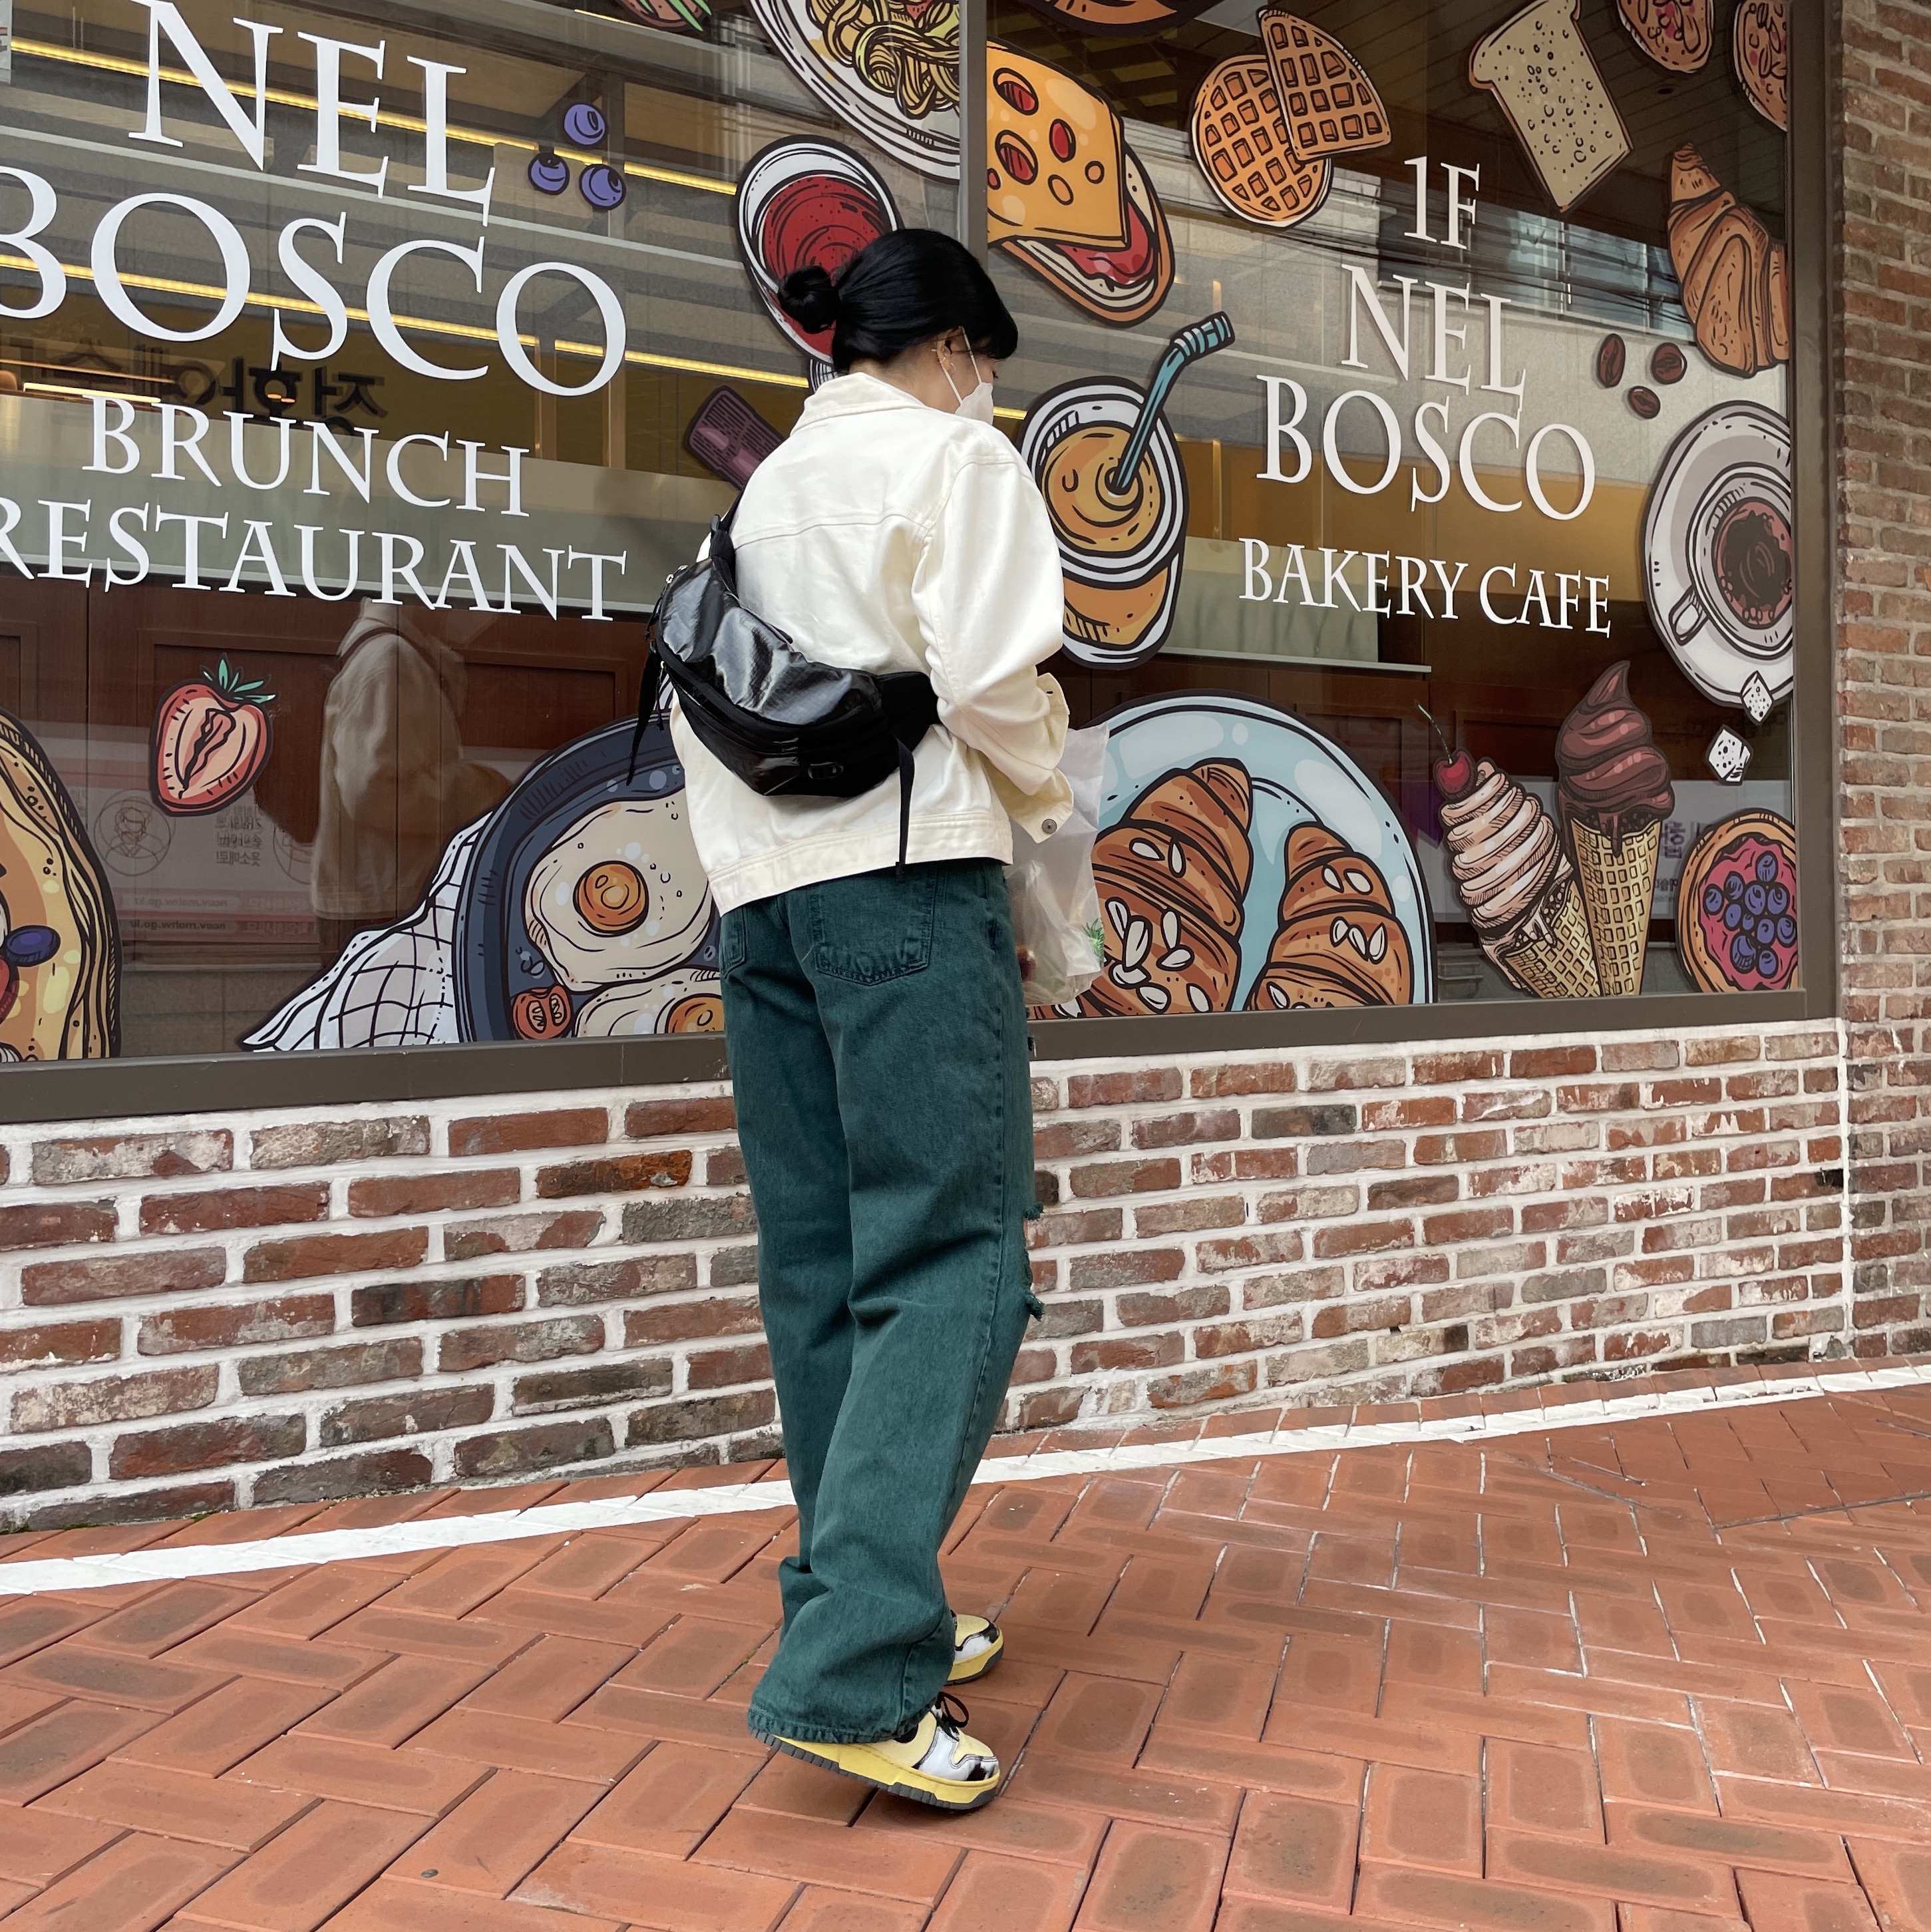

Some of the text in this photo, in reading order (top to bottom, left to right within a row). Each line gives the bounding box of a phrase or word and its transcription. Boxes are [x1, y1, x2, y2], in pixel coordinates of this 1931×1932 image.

[128, 0, 496, 227] NEL
[1404, 156, 1480, 250] 1F
[1340, 264, 1526, 399] NEL
[83, 395, 530, 517] BRUNCH
[1256, 375, 1596, 520] BOSCO
[1238, 538, 1612, 639] BAKERY CAFE
